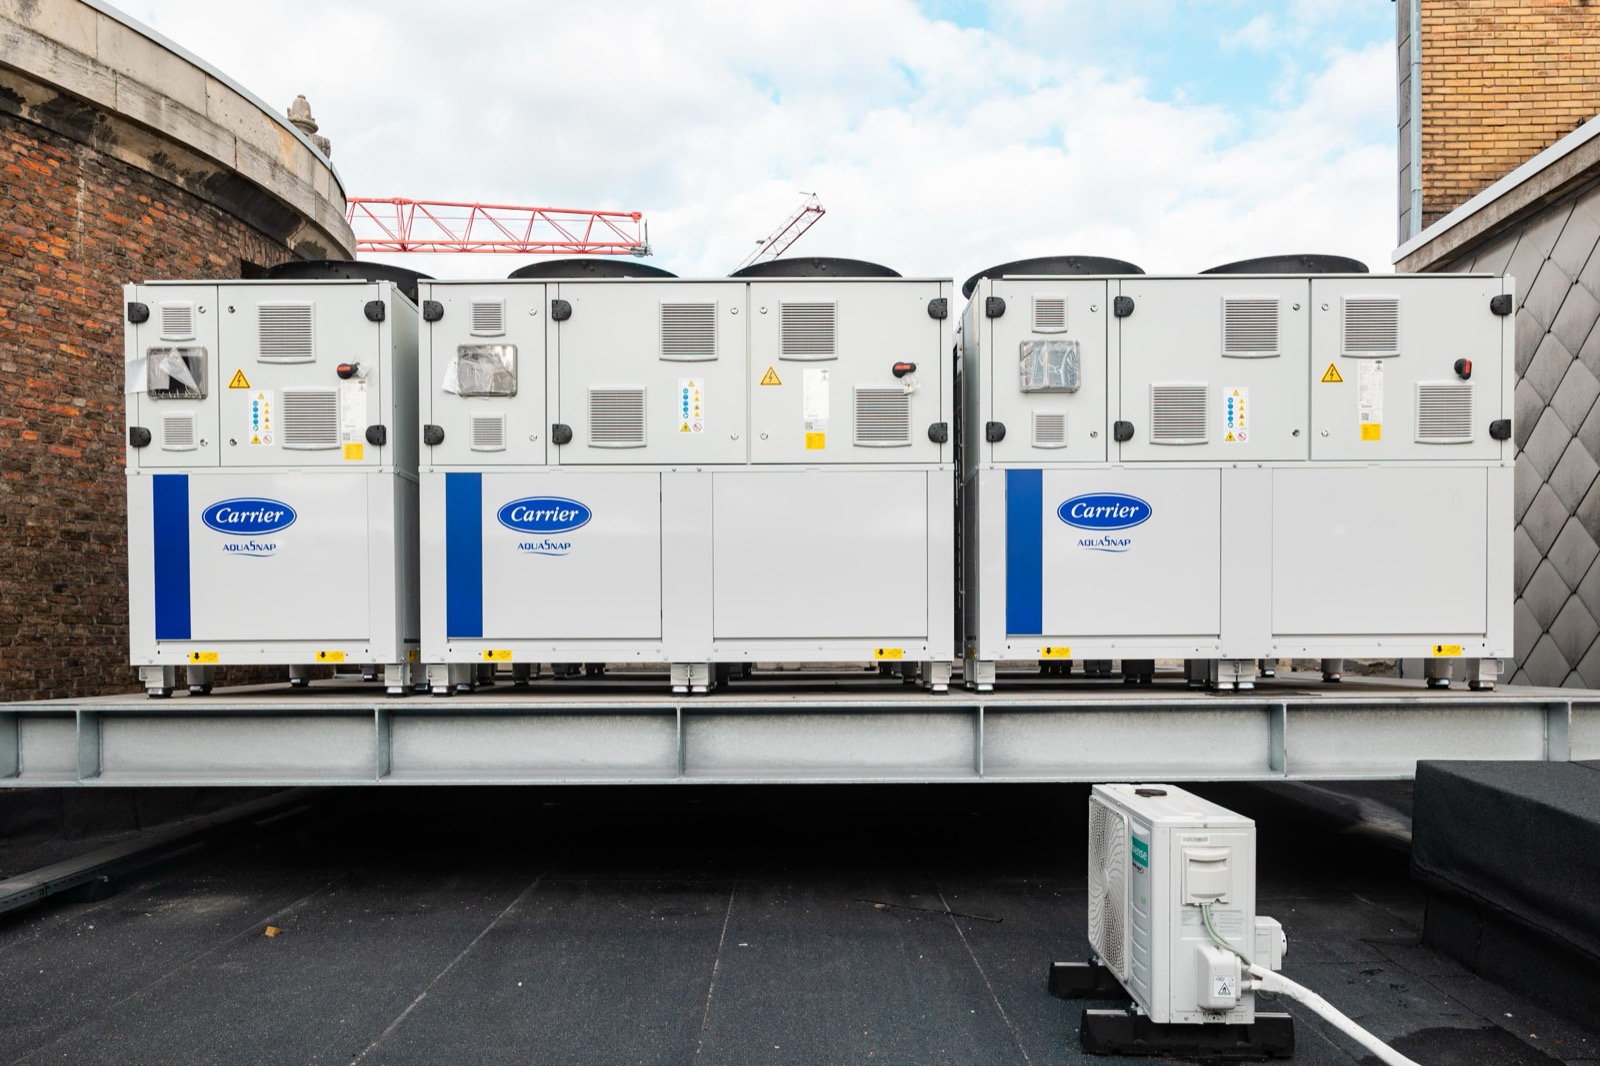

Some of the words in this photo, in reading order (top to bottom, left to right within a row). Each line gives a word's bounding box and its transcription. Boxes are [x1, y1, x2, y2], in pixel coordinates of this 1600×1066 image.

[215, 507, 284, 524] Carrier
[511, 505, 579, 522] Carrier
[1071, 502, 1139, 519] Carrier
[222, 540, 277, 552] AQUASNAP
[517, 539, 571, 550] AQUASNAP
[1077, 535, 1131, 547] AQUASNAP
